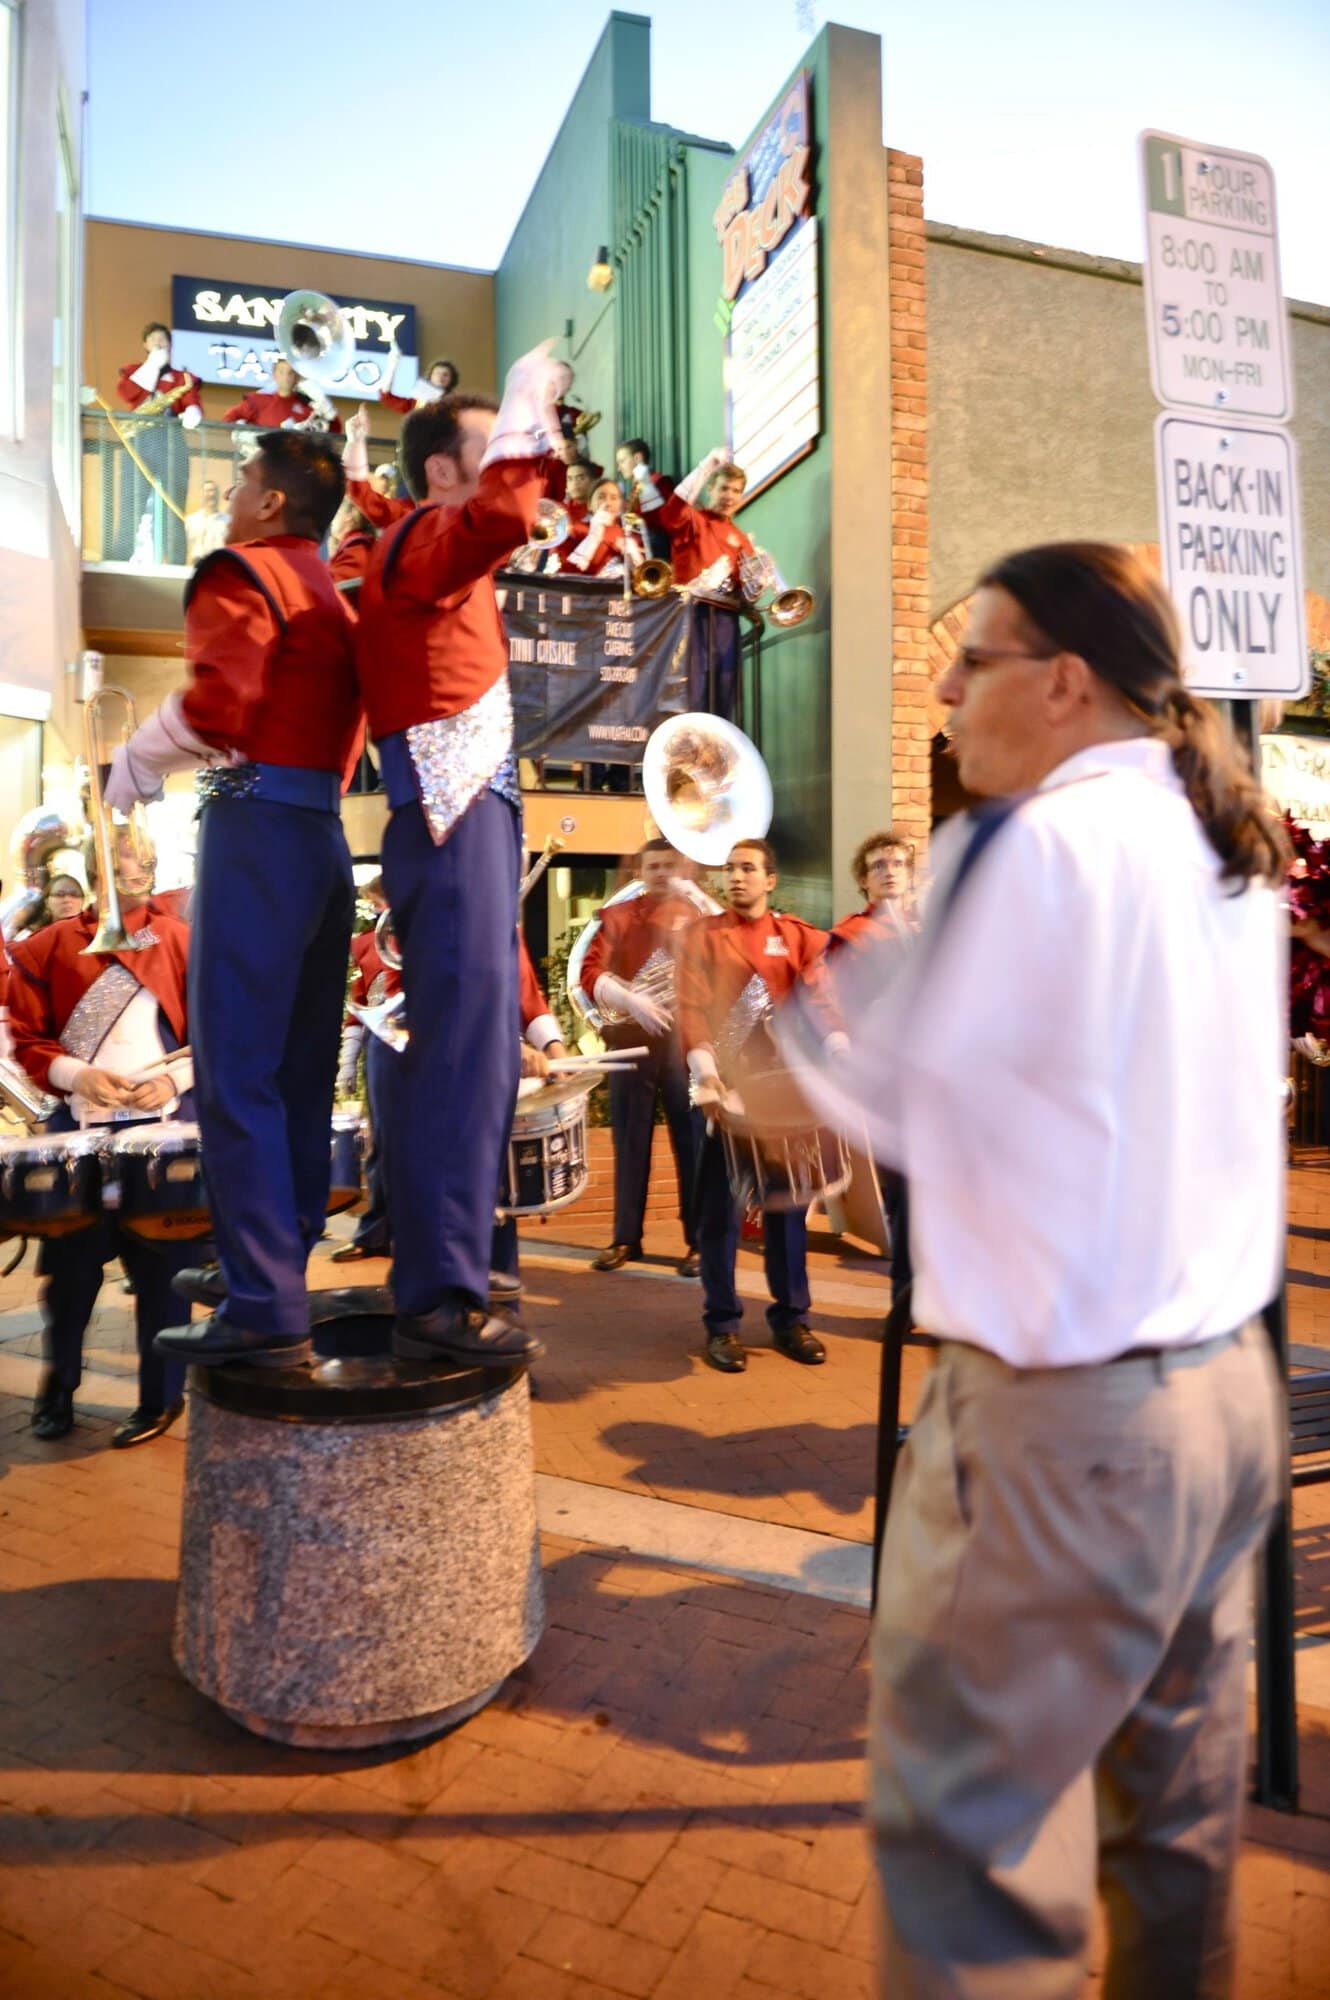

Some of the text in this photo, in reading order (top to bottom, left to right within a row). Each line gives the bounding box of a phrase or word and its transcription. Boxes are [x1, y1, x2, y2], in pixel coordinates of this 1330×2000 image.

[1188, 187, 1267, 226] PARKING
[1161, 234, 1264, 282] 8:00 AM
[192, 290, 405, 341] SANTY
[1204, 281, 1228, 306] TO
[1161, 304, 1269, 350] 5:00 PM
[208, 344, 384, 390] TATO
[1183, 354, 1262, 387] MON-FRI
[1174, 458, 1283, 517] BACK-IN
[1178, 523, 1285, 579] PARKING
[1190, 585, 1281, 654] ONLY
